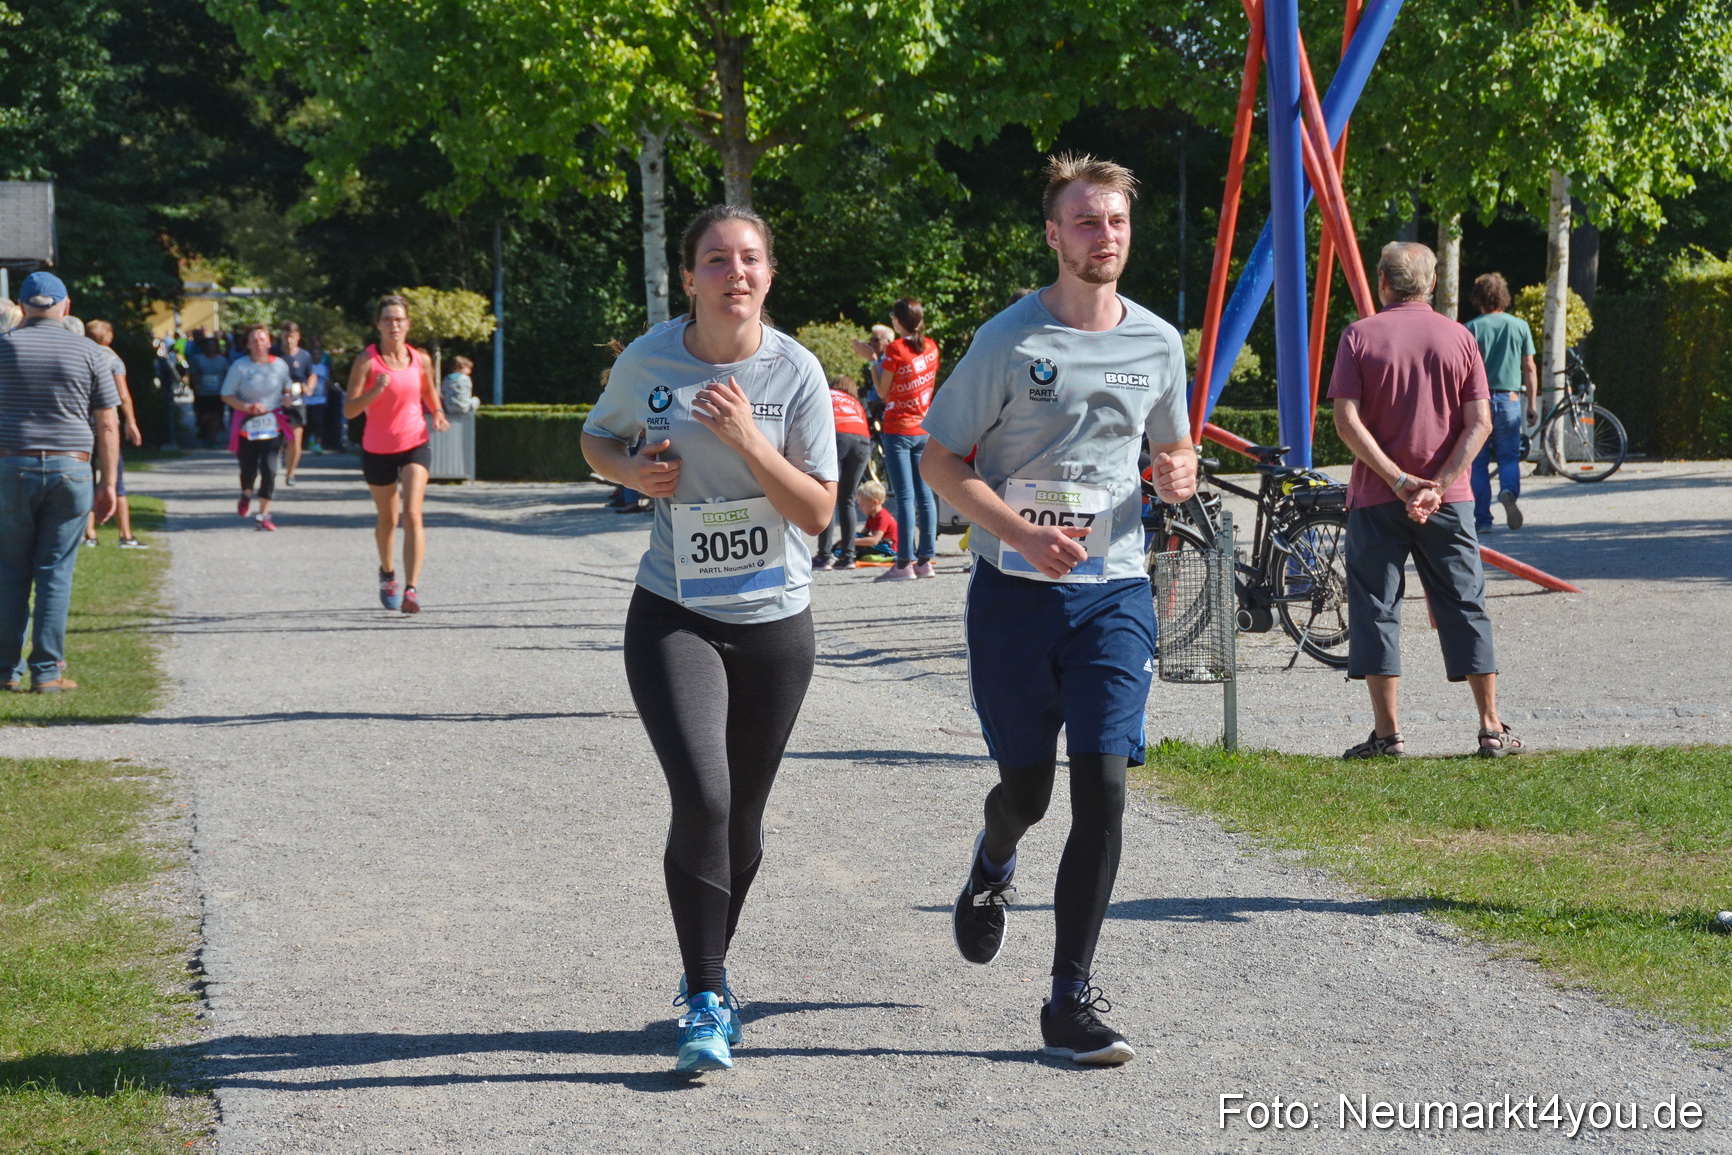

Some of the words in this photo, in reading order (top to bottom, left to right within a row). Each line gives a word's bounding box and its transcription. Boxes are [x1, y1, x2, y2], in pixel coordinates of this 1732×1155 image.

[1031, 357, 1057, 368] BMW
[1104, 372, 1150, 388] BOCK
[1029, 388, 1058, 397] PARTL
[750, 402, 783, 417] CK
[646, 417, 670, 425] PARTL
[1035, 490, 1081, 503] BOCK
[702, 508, 750, 524] BOCK
[690, 526, 769, 564] 3050
[699, 566, 722, 574] PARTL
[723, 562, 756, 573] Neumarkt
